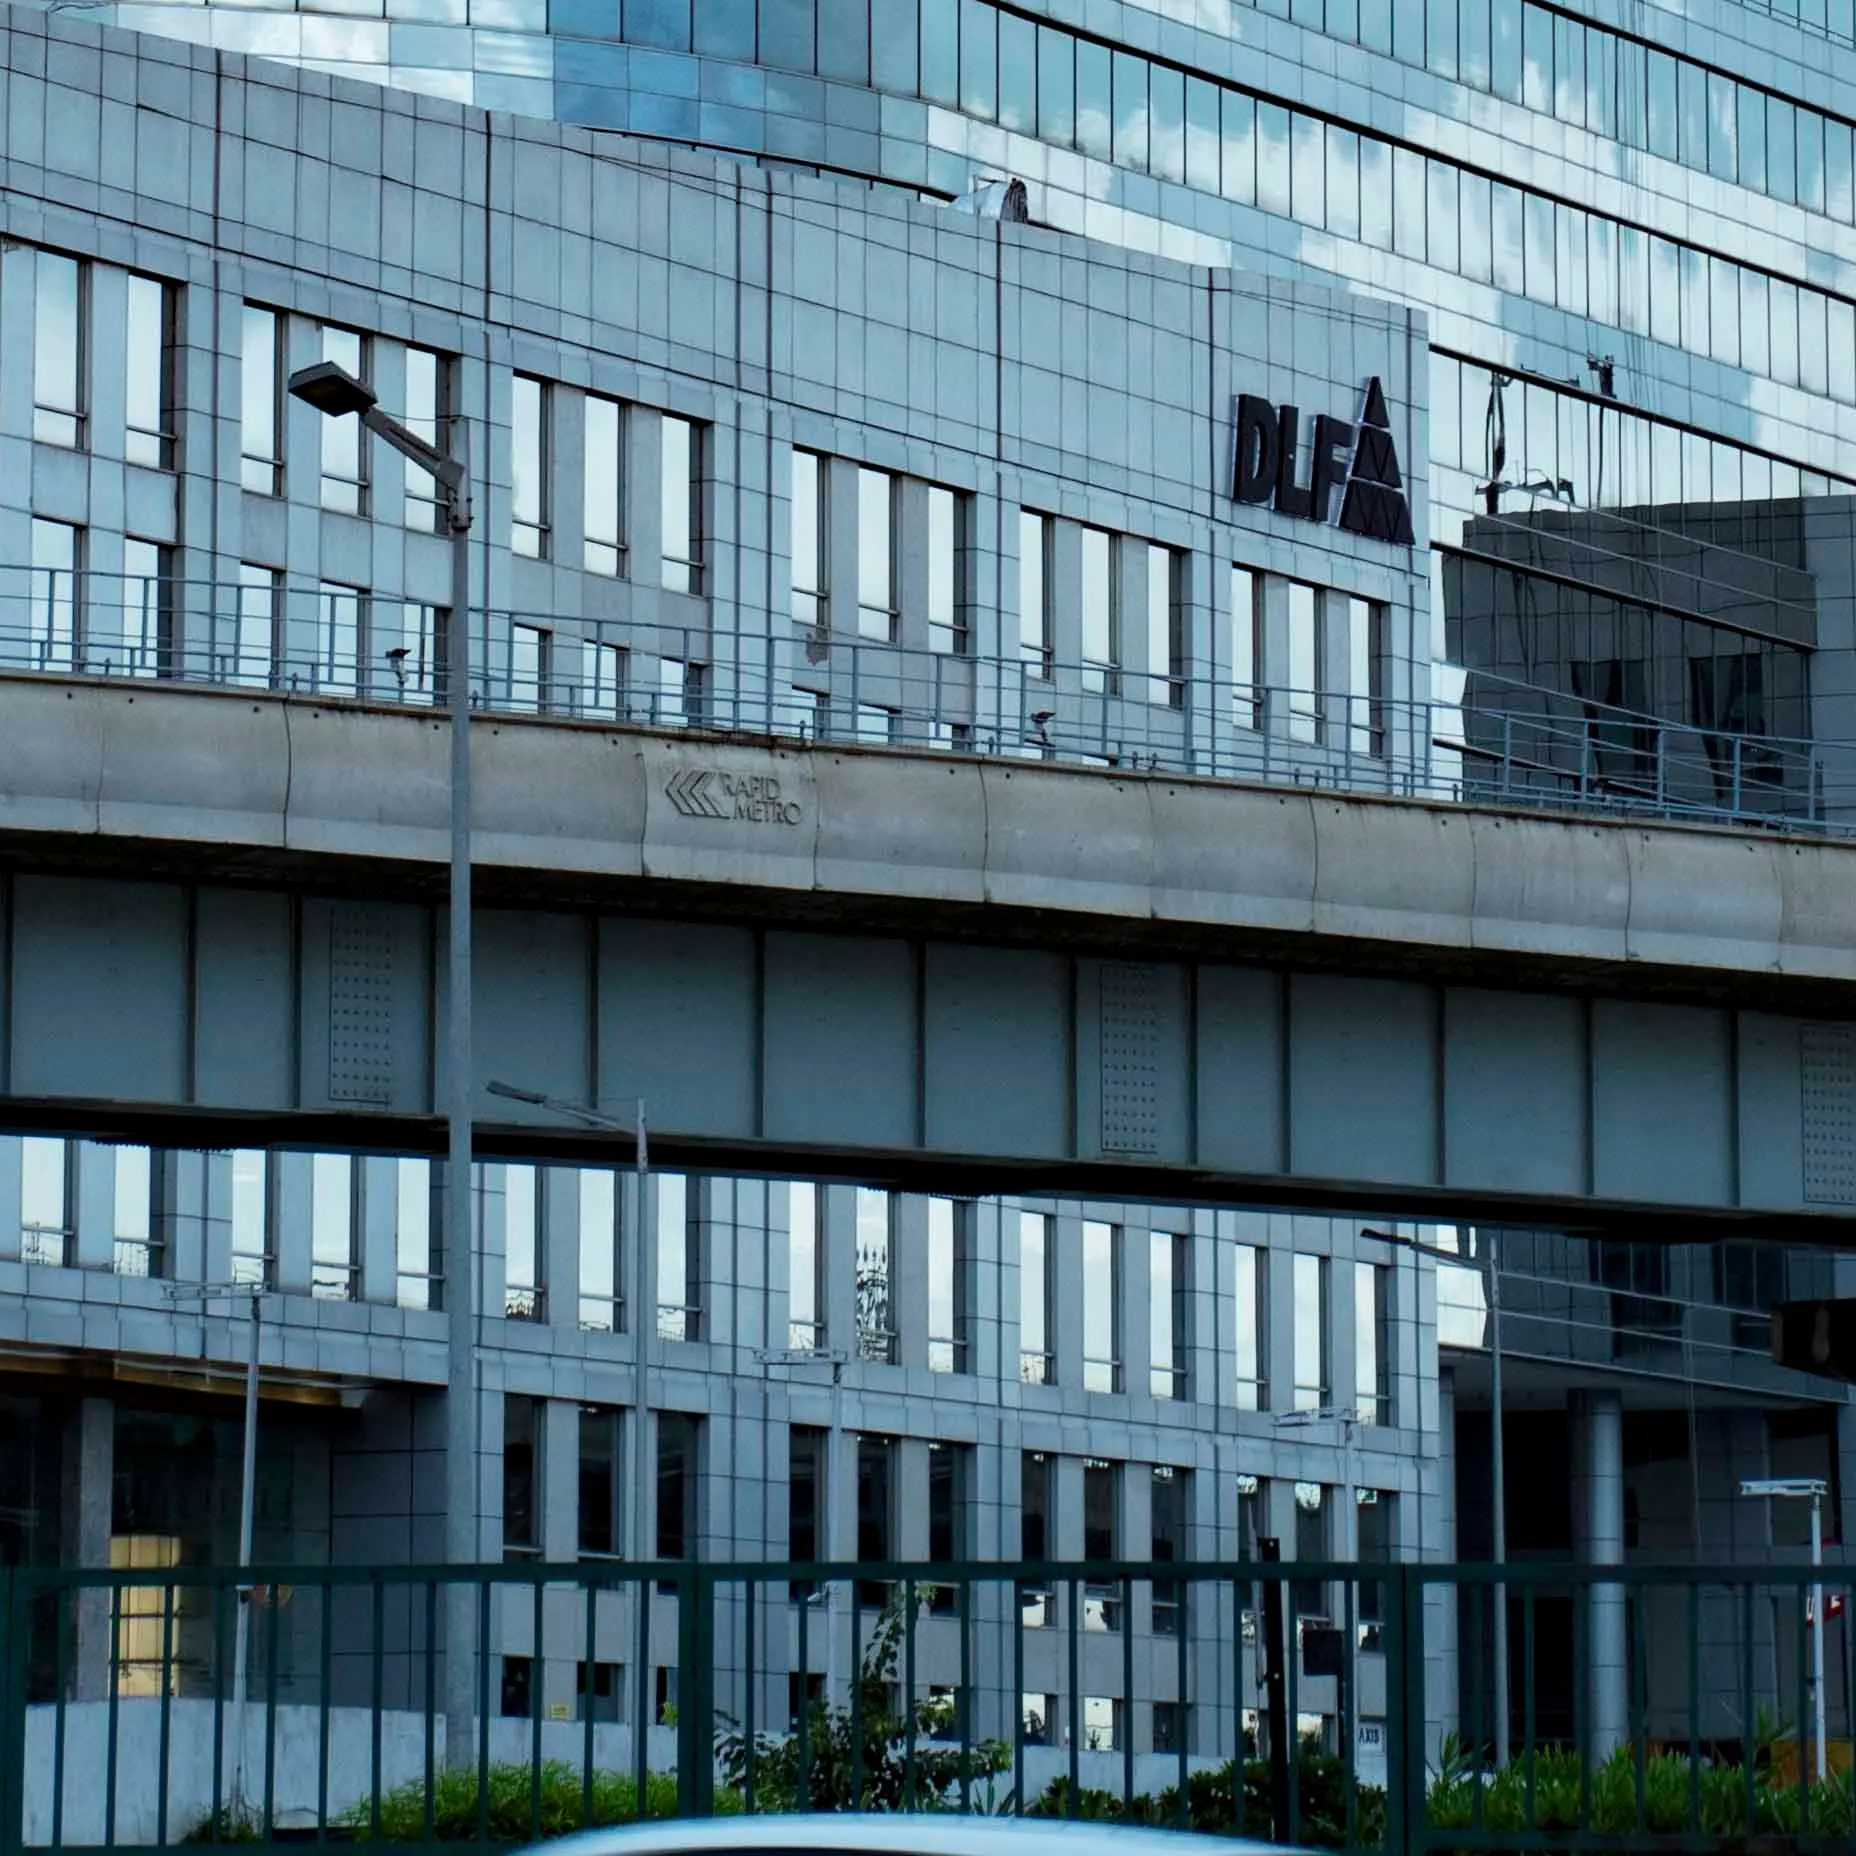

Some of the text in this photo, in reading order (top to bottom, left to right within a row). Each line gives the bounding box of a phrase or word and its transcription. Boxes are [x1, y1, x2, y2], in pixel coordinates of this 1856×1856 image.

[1231, 392, 1355, 524] DLF
[718, 770, 782, 800] RAPID
[732, 798, 804, 826] METRO
